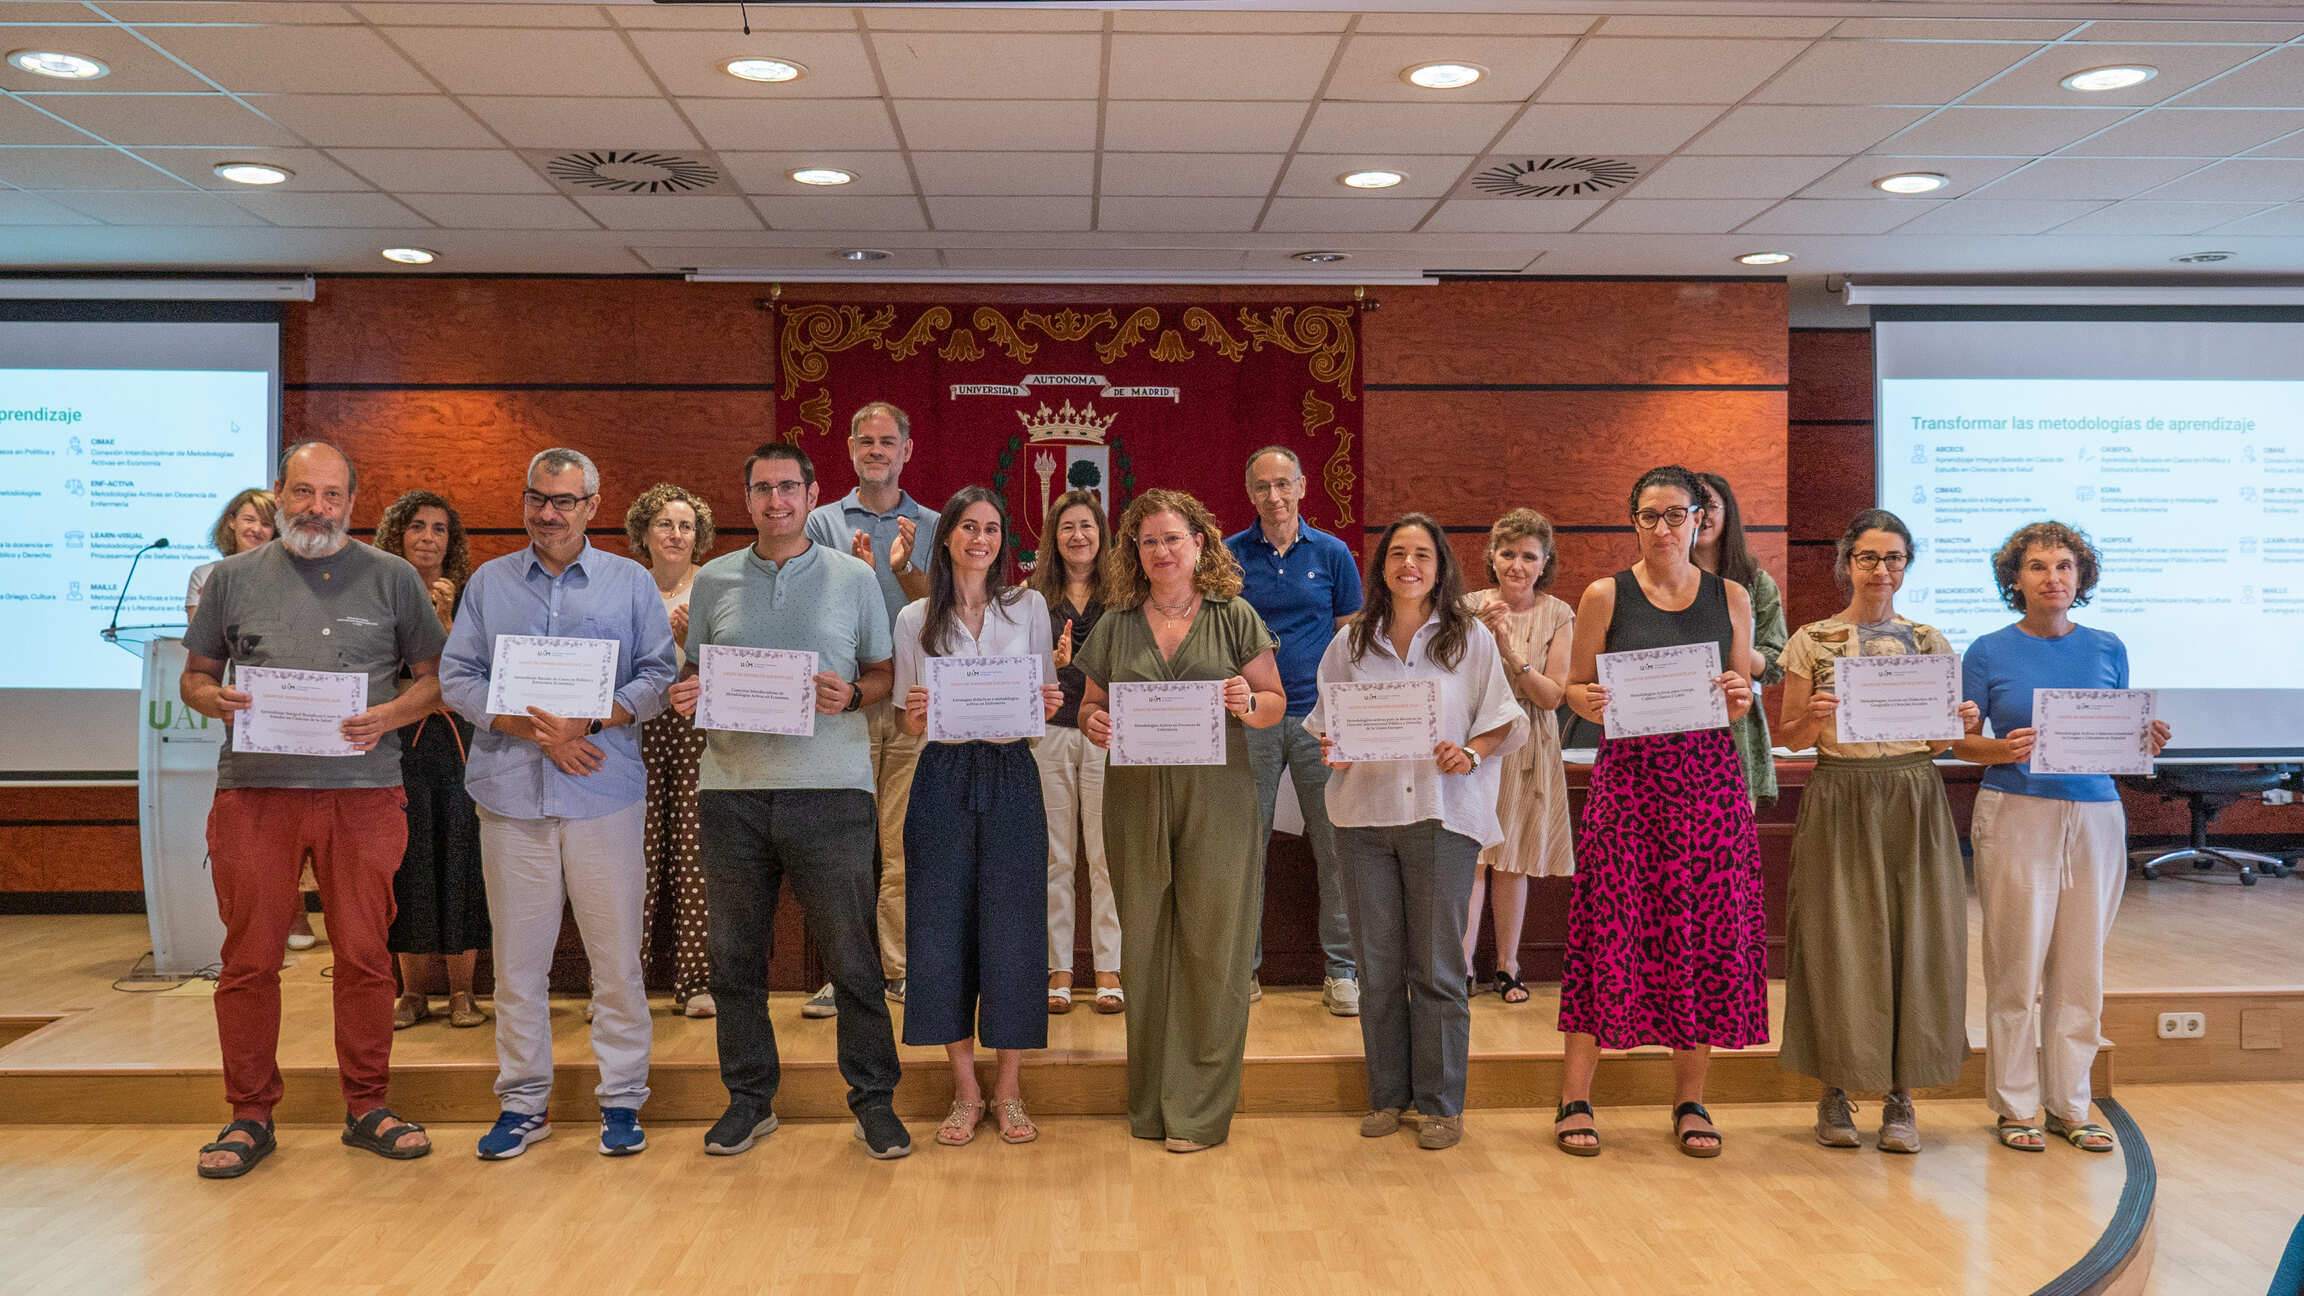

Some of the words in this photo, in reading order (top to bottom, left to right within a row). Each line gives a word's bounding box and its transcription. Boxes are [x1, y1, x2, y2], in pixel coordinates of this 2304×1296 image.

[1033, 376, 1097, 384] AUTONOMA
[959, 386, 1018, 395] UNIVERSIDAD
[1114, 388, 1124, 396] DE
[1132, 388, 1169, 396] MADRID
[1912, 416, 2007, 430] Transformar
[2012, 416, 2033, 430] las
[2038, 416, 2141, 433] metodologías
[2146, 416, 2164, 430] de
[2169, 417, 2256, 433] aprendizaje
[149, 701, 208, 730] UA
